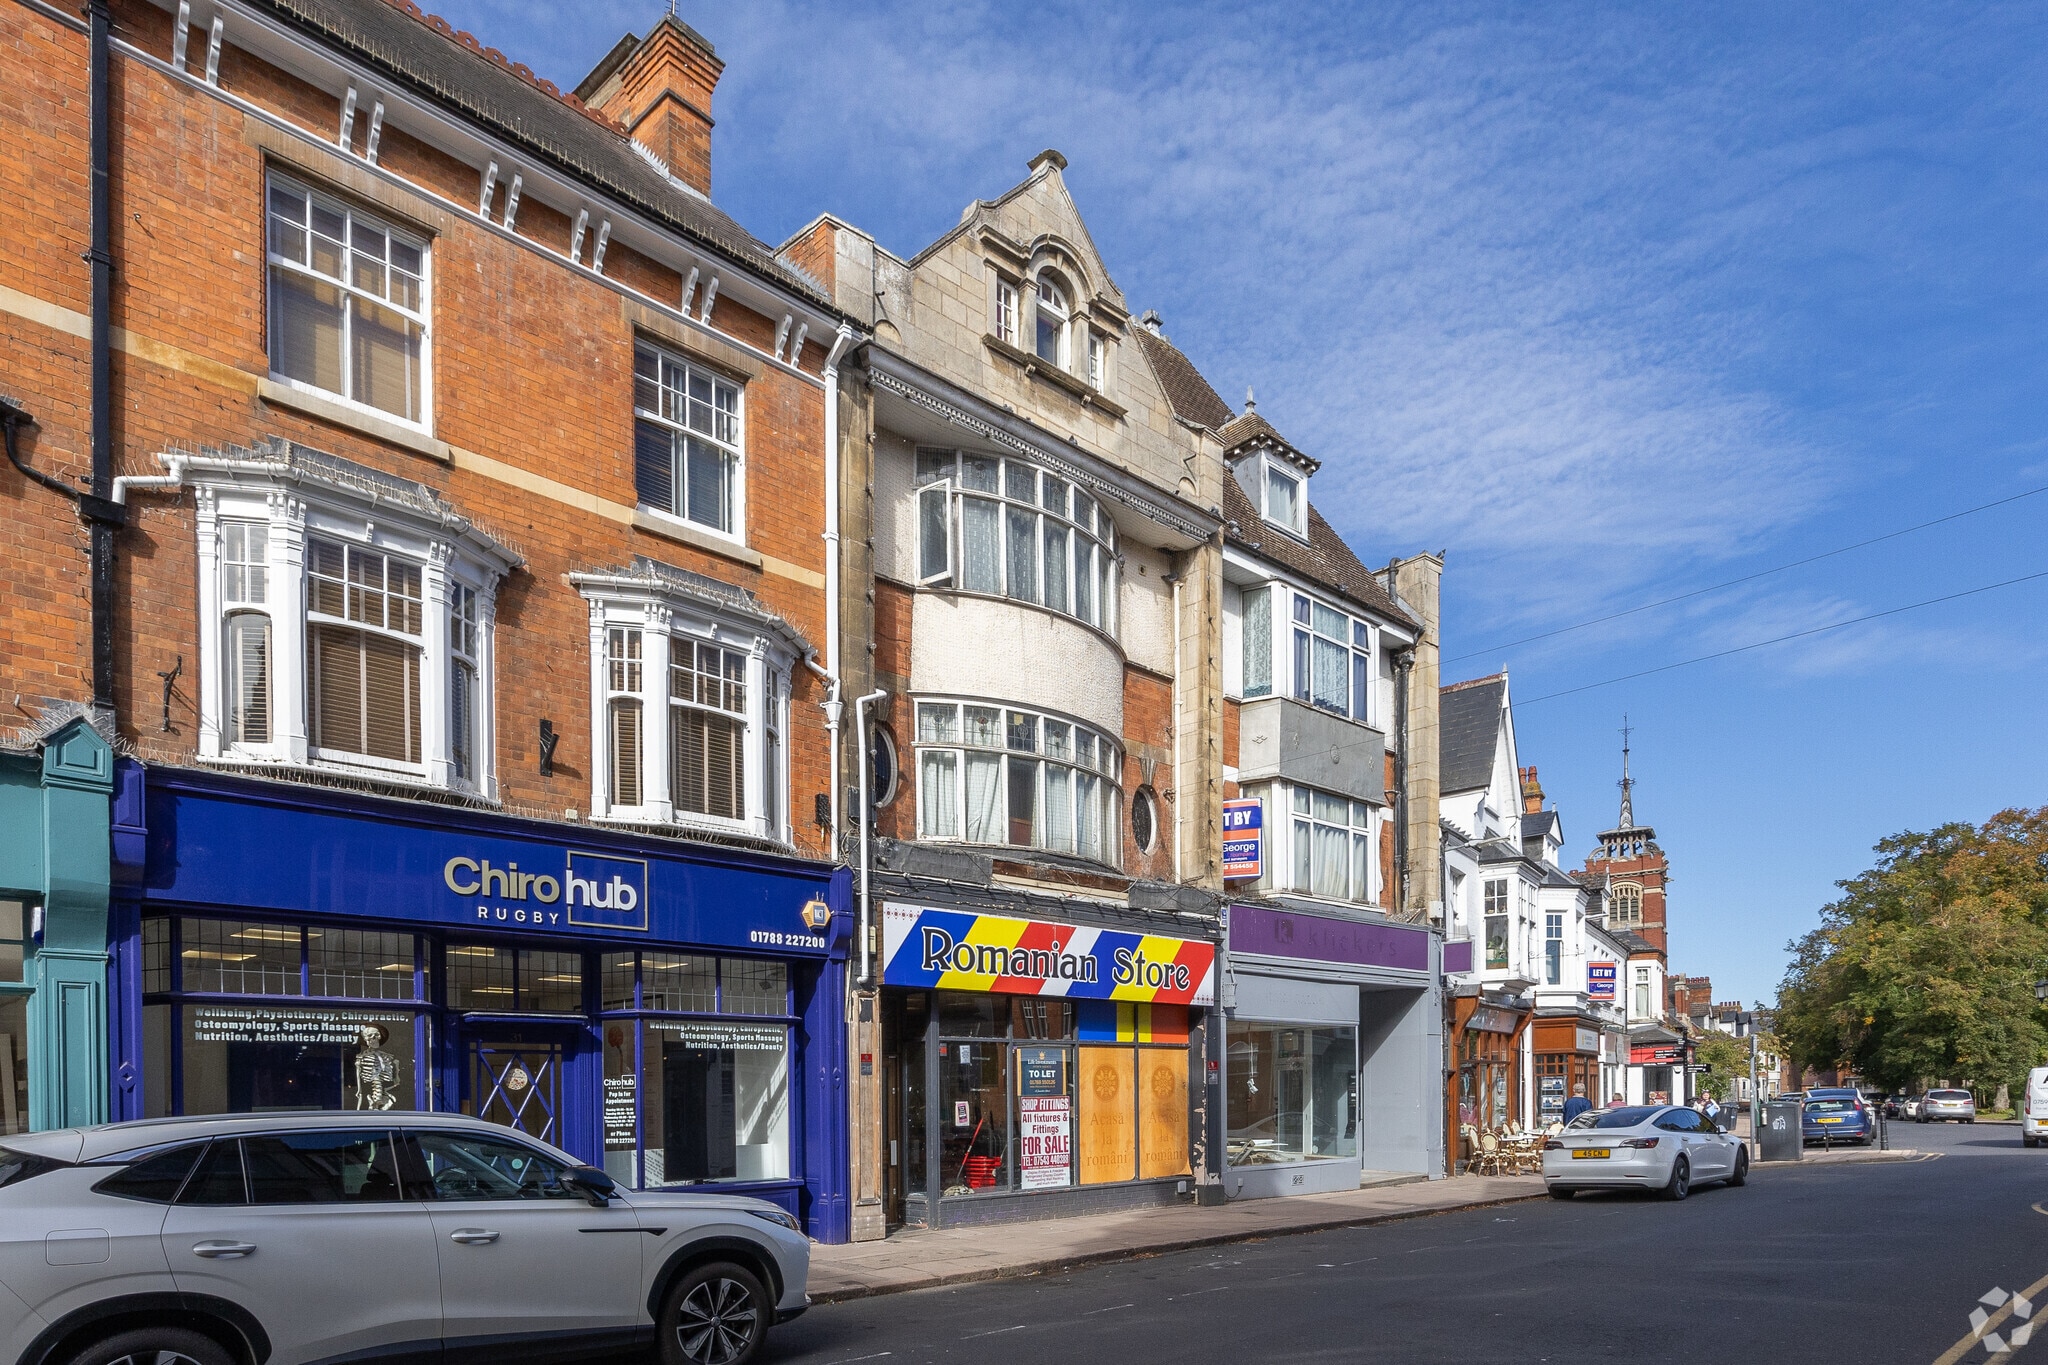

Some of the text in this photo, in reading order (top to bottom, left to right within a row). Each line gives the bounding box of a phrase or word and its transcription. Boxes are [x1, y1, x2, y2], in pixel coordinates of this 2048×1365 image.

[1233, 810, 1252, 826] BY
[1223, 843, 1256, 853] George
[444, 856, 638, 911] Chiro hub
[478, 906, 559, 925] RUGBY
[750, 930, 825, 949] 01788 227200
[921, 926, 1191, 991] Romanian Store
[1592, 968, 1603, 977] LET
[341, 1011, 409, 1022] Chiropractic,
[194, 1019, 366, 1033] Osteomyology, Sports Massage
[194, 1031, 359, 1045] Nutrition, Aesthetics/Beauty
[732, 1033, 755, 1042] Sports
[755, 1034, 783, 1043] Massage
[685, 1041, 783, 1052] Nutrition, Aesthetics/Beauty
[1029, 1070, 1056, 1078] TO LET
[1022, 1097, 1069, 1111] SHOP FITTINGS
[1022, 1112, 1068, 1123] All fixtures &
[1090, 1112, 1124, 1126] Acasă
[1032, 1124, 1059, 1135] Fittings
[1022, 1135, 1069, 1155] FOR SALE
[1102, 1132, 1112, 1145] la
[1023, 1156, 1033, 1167] TEL:
[1087, 1150, 1127, 1166] români
